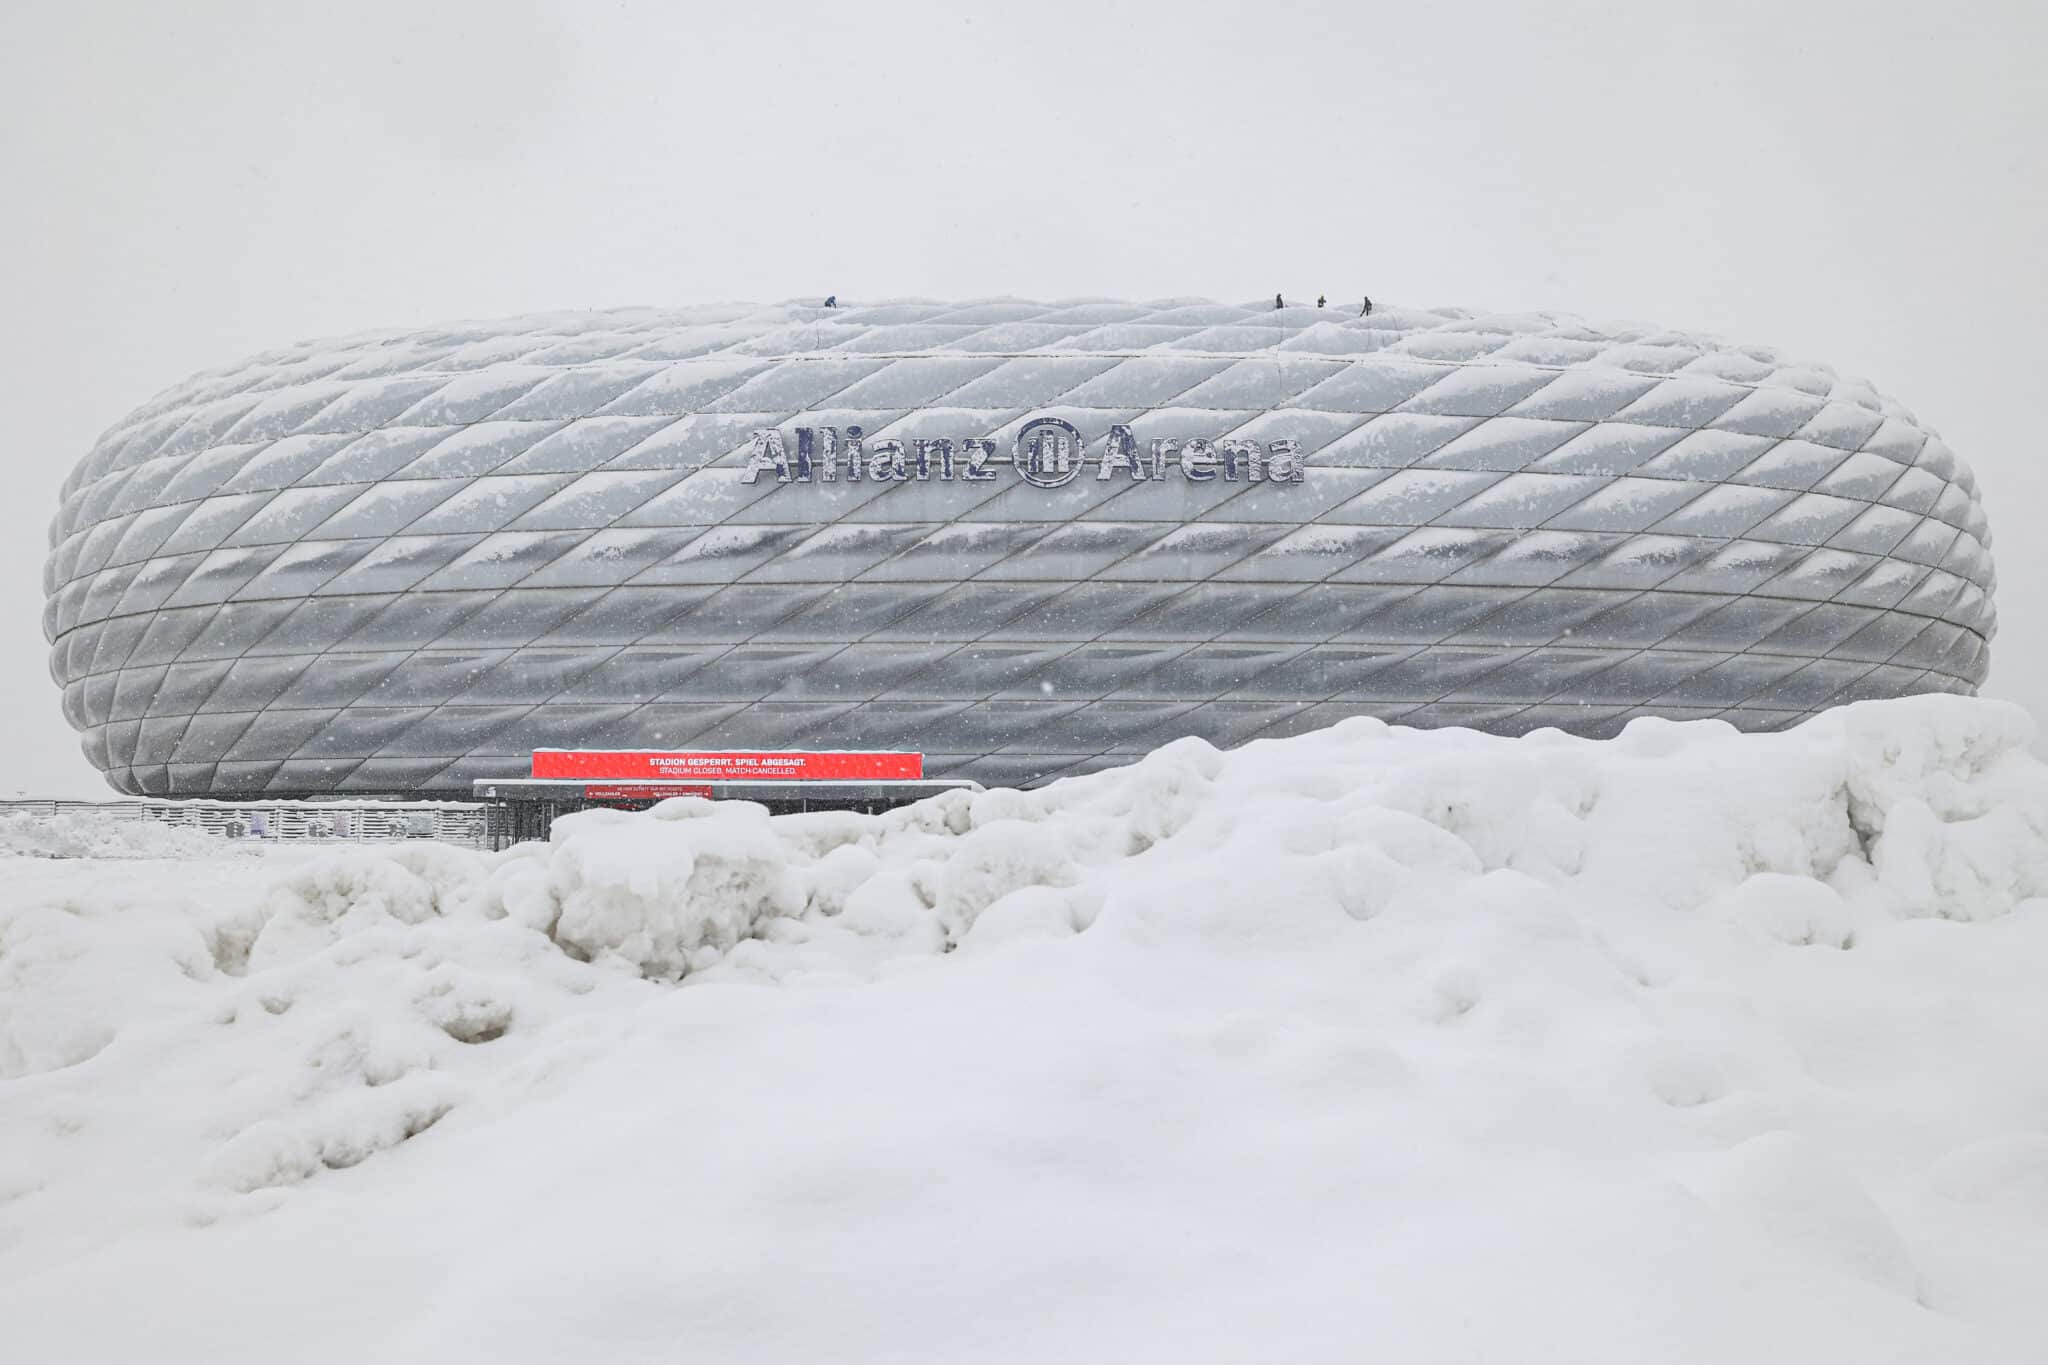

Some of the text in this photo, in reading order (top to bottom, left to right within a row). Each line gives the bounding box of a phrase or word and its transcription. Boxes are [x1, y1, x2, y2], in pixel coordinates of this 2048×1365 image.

[741, 424, 1305, 484] Allianz Arena
[649, 758, 806, 767] STADION GESPERRT. SPIEL ABGESAGT.
